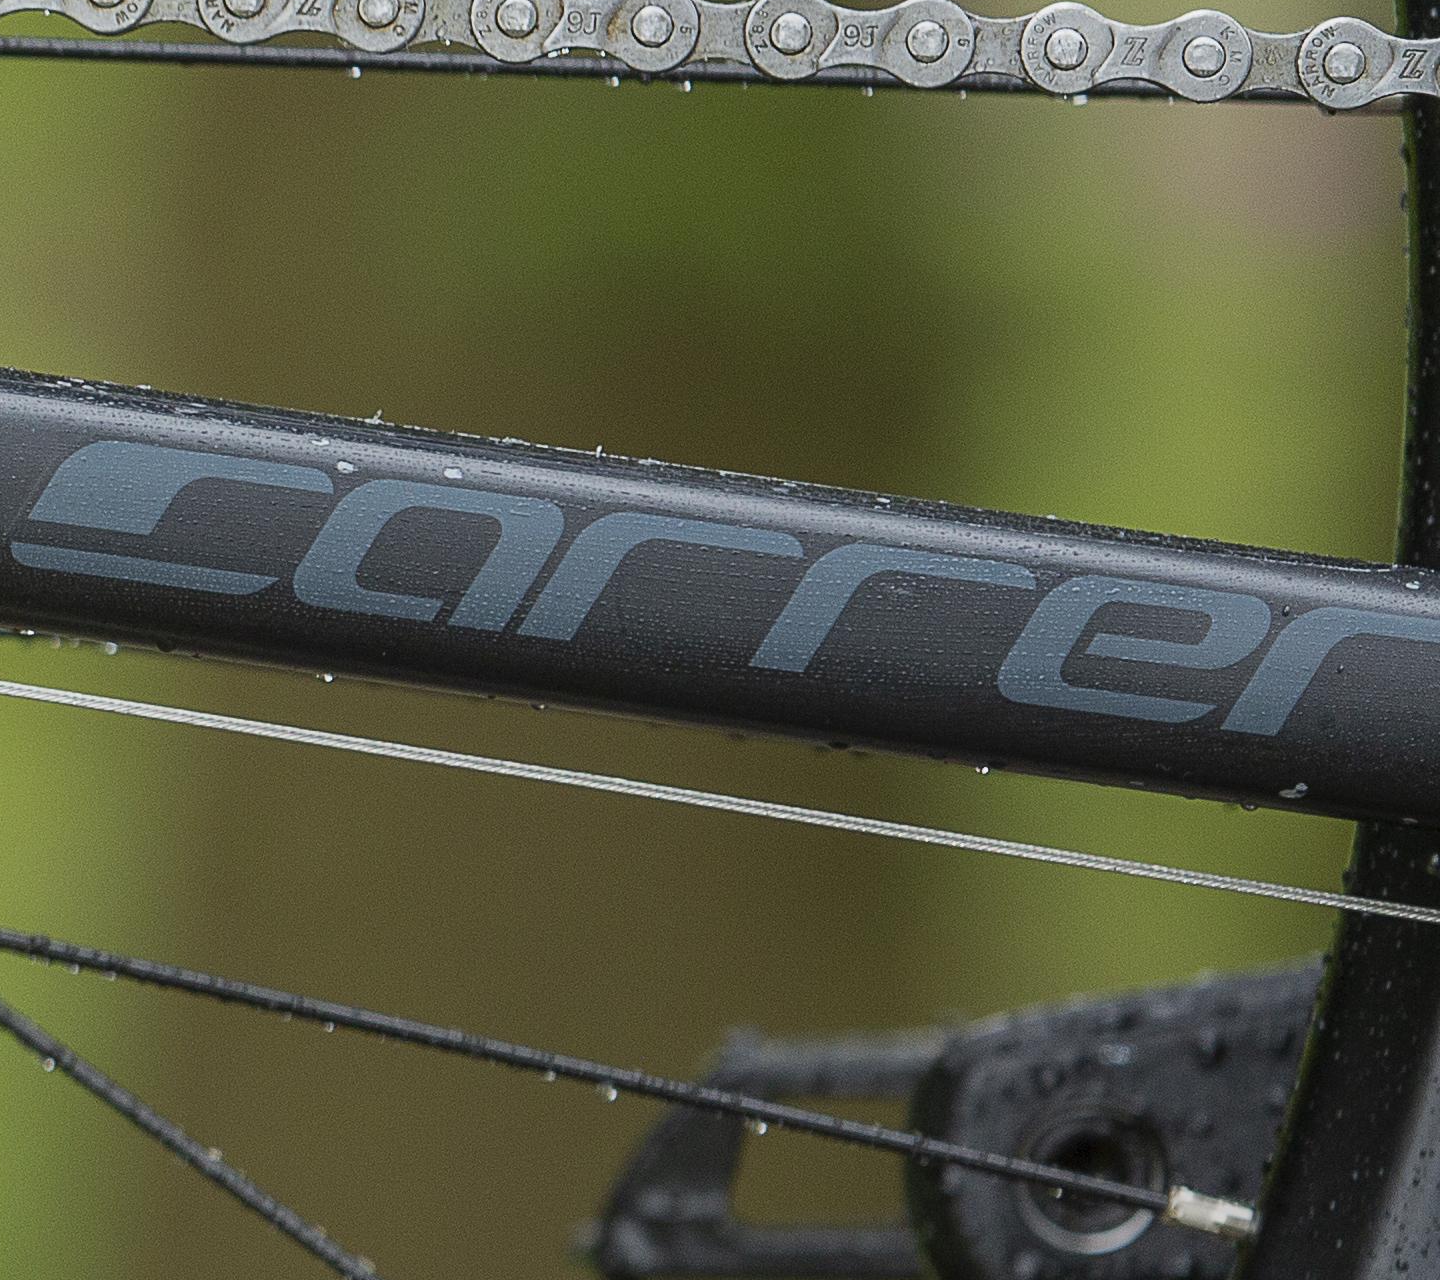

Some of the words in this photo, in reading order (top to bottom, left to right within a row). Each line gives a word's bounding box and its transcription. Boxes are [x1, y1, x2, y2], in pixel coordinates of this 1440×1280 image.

[567, 10, 601, 35] 9J
[843, 24, 879, 49] 9J
[1027, 12, 1057, 85] NARROW
[1121, 36, 1149, 67] Z
[1219, 26, 1242, 87] KMC
[1304, 25, 1337, 99] NARROW
[1398, 48, 1429, 80] Z
